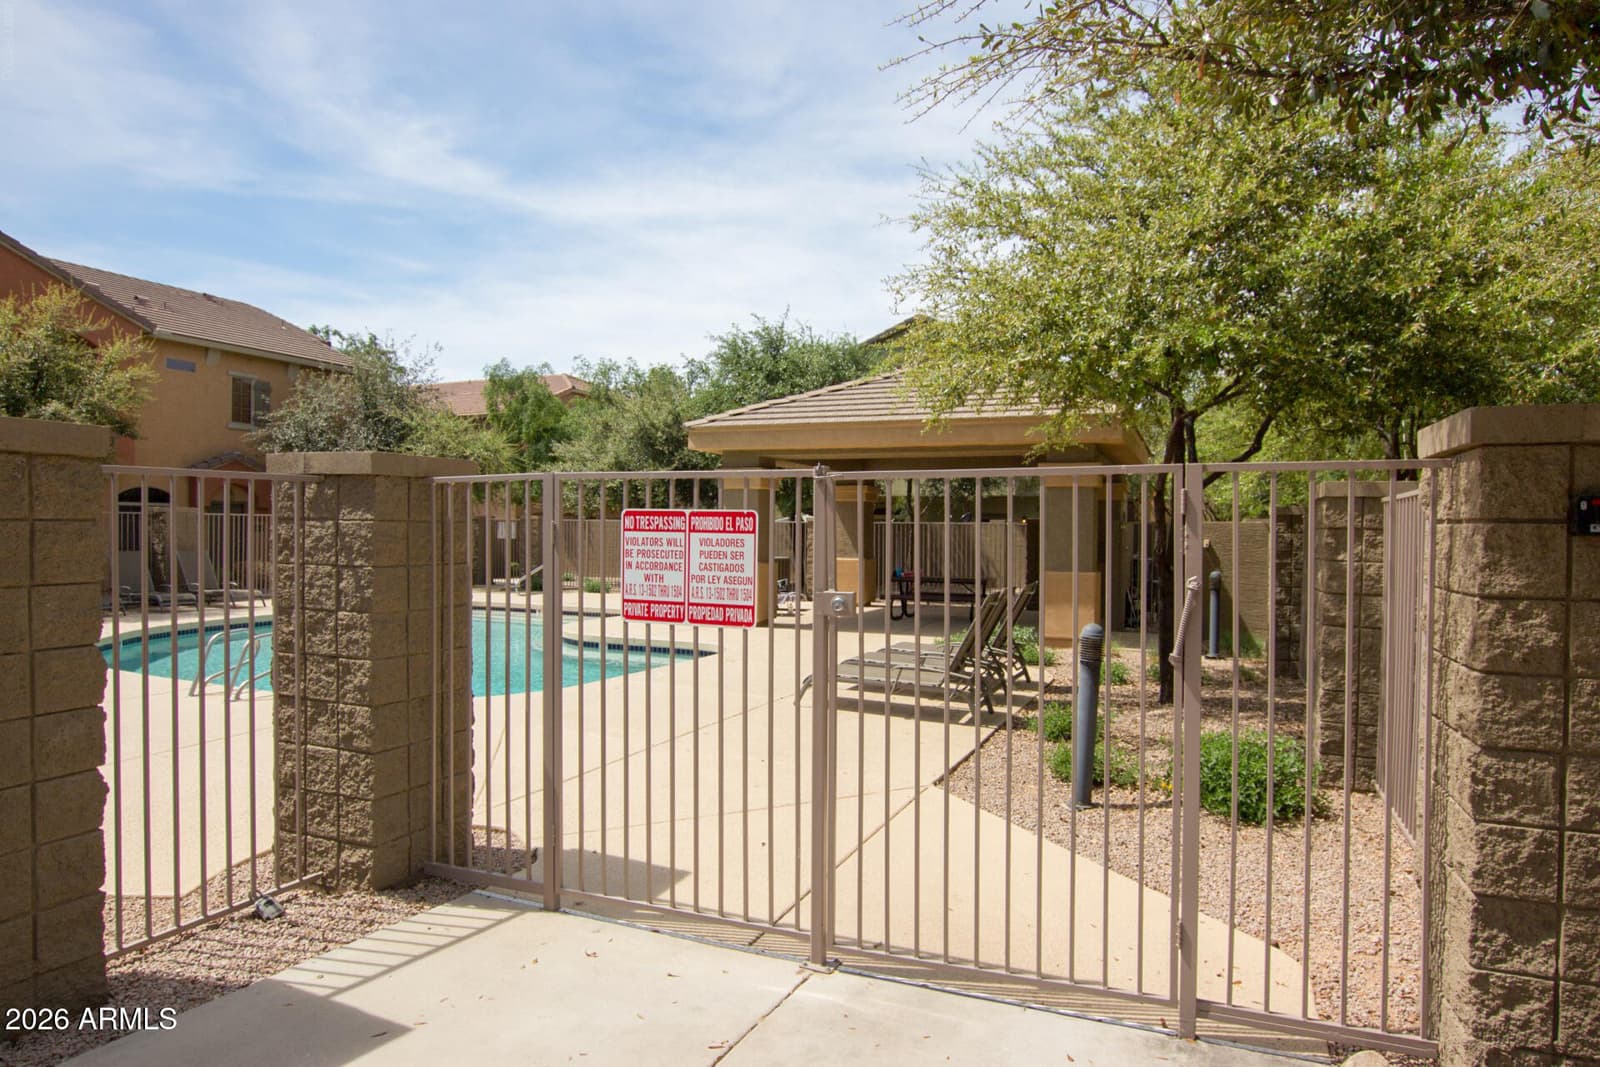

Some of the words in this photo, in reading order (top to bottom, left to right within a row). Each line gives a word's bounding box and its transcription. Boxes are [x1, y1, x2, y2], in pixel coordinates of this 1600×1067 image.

[625, 516, 634, 529] NO
[636, 516, 685, 530] TRESPASSING
[691, 517, 723, 530] PROHIBIDO
[726, 517, 733, 531] EL
[736, 517, 753, 531] PASO
[625, 537, 663, 547] VIOLATORS
[666, 538, 683, 548] WILL
[699, 538, 744, 547] VIOLADORES
[625, 549, 634, 558] BE
[637, 550, 683, 560] PROSECUTED
[700, 551, 727, 560] PUEDEN
[730, 551, 744, 560] SER
[626, 562, 632, 570] IN
[635, 562, 683, 572] ACCORDANCE
[699, 563, 744, 572] CASTIGADOS
[644, 574, 664, 583] WITH
[691, 575, 705, 584] POR
[708, 575, 721, 584] LEY
[723, 576, 752, 585] ASEGUN
[658, 585, 669, 597] THRU
[726, 588, 738, 600] THRU
[624, 602, 648, 616] PRIVATE
[650, 604, 684, 618] PROPERTY
[690, 606, 723, 620] PROPIEDAD
[726, 608, 752, 622] PRIVADA
